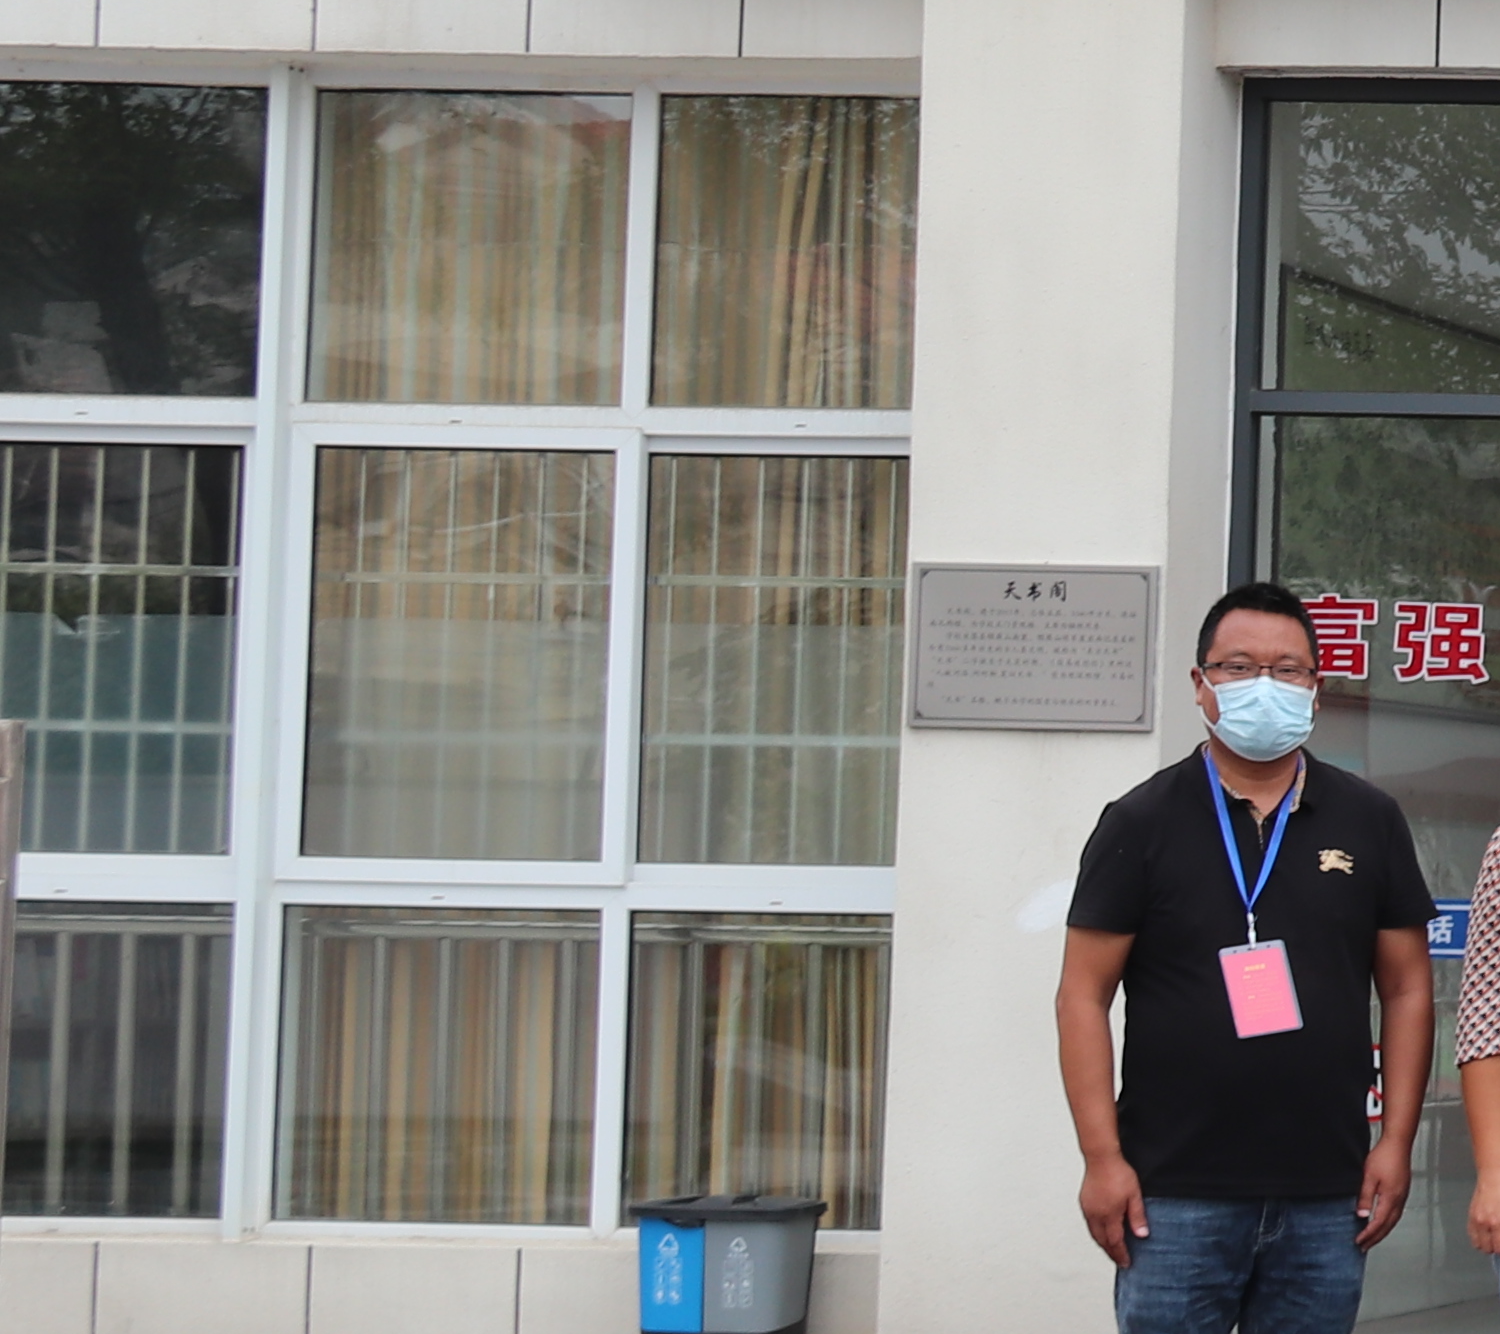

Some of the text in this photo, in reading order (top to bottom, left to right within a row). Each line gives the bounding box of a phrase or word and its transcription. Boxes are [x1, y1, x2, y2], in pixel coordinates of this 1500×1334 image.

[1003, 580, 1068, 602] 天书阁
[1301, 593, 1490, 685] 富强
